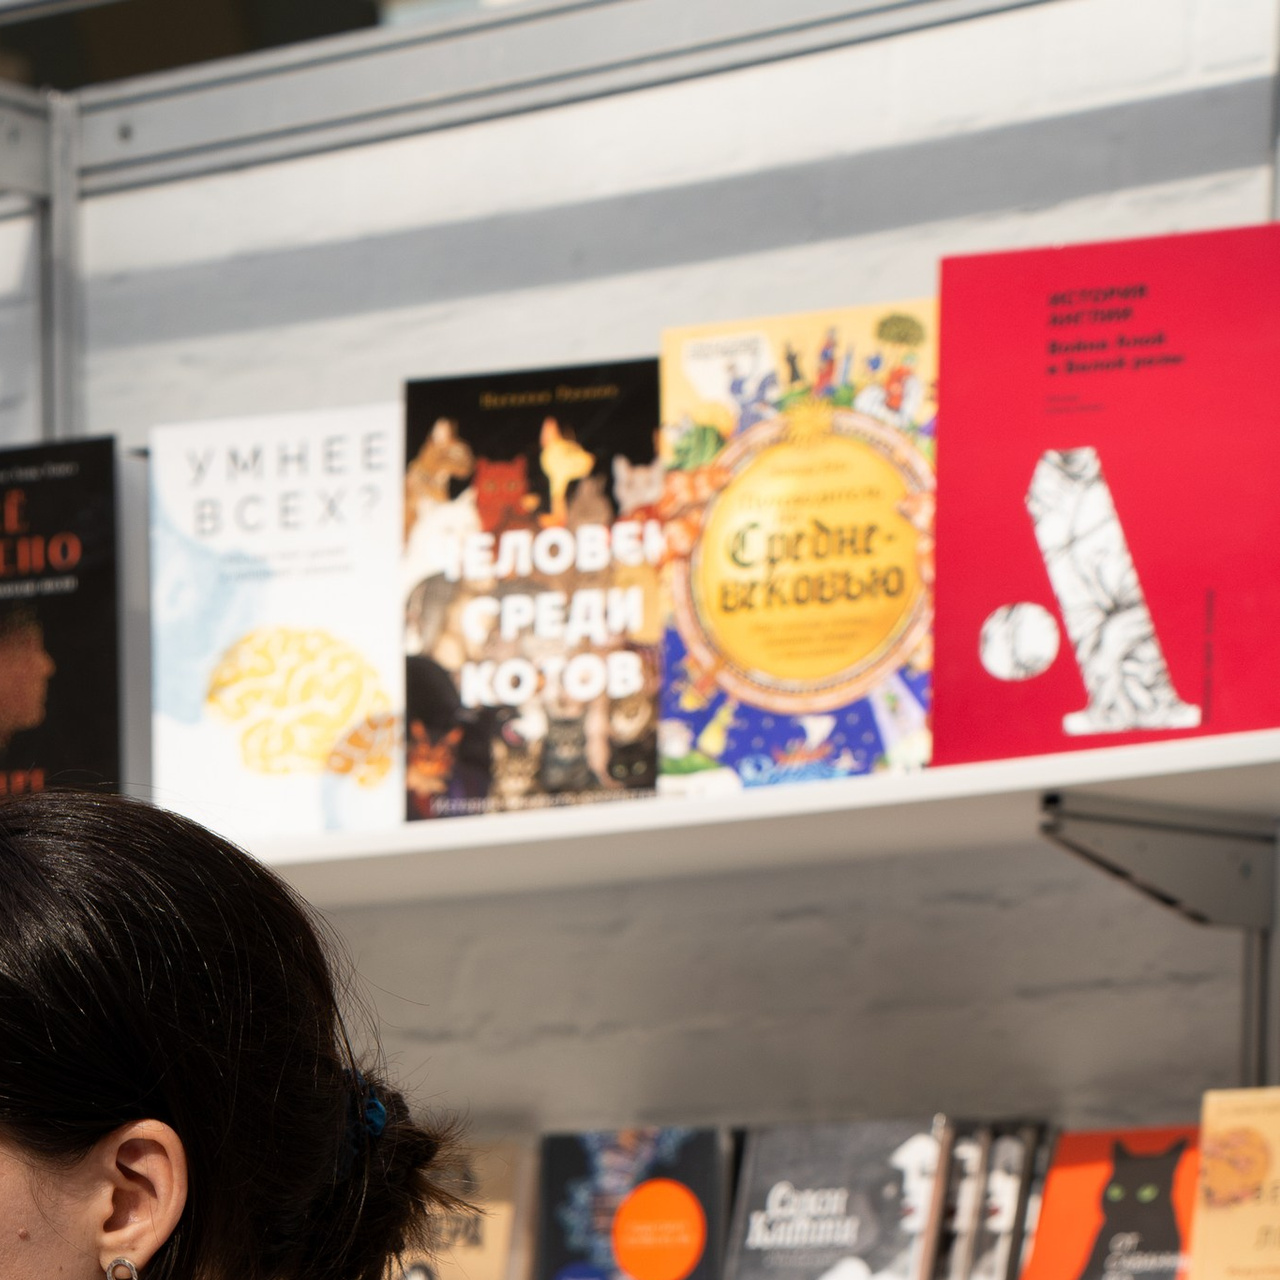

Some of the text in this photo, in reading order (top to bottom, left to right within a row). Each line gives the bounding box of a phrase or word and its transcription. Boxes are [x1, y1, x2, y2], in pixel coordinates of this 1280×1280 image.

[186, 431, 390, 484] УМНЕЕ
[193, 484, 381, 537] ВСЕХ?
[461, 585, 644, 649] СРЕДИ
[459, 649, 644, 710] КОТОВ
